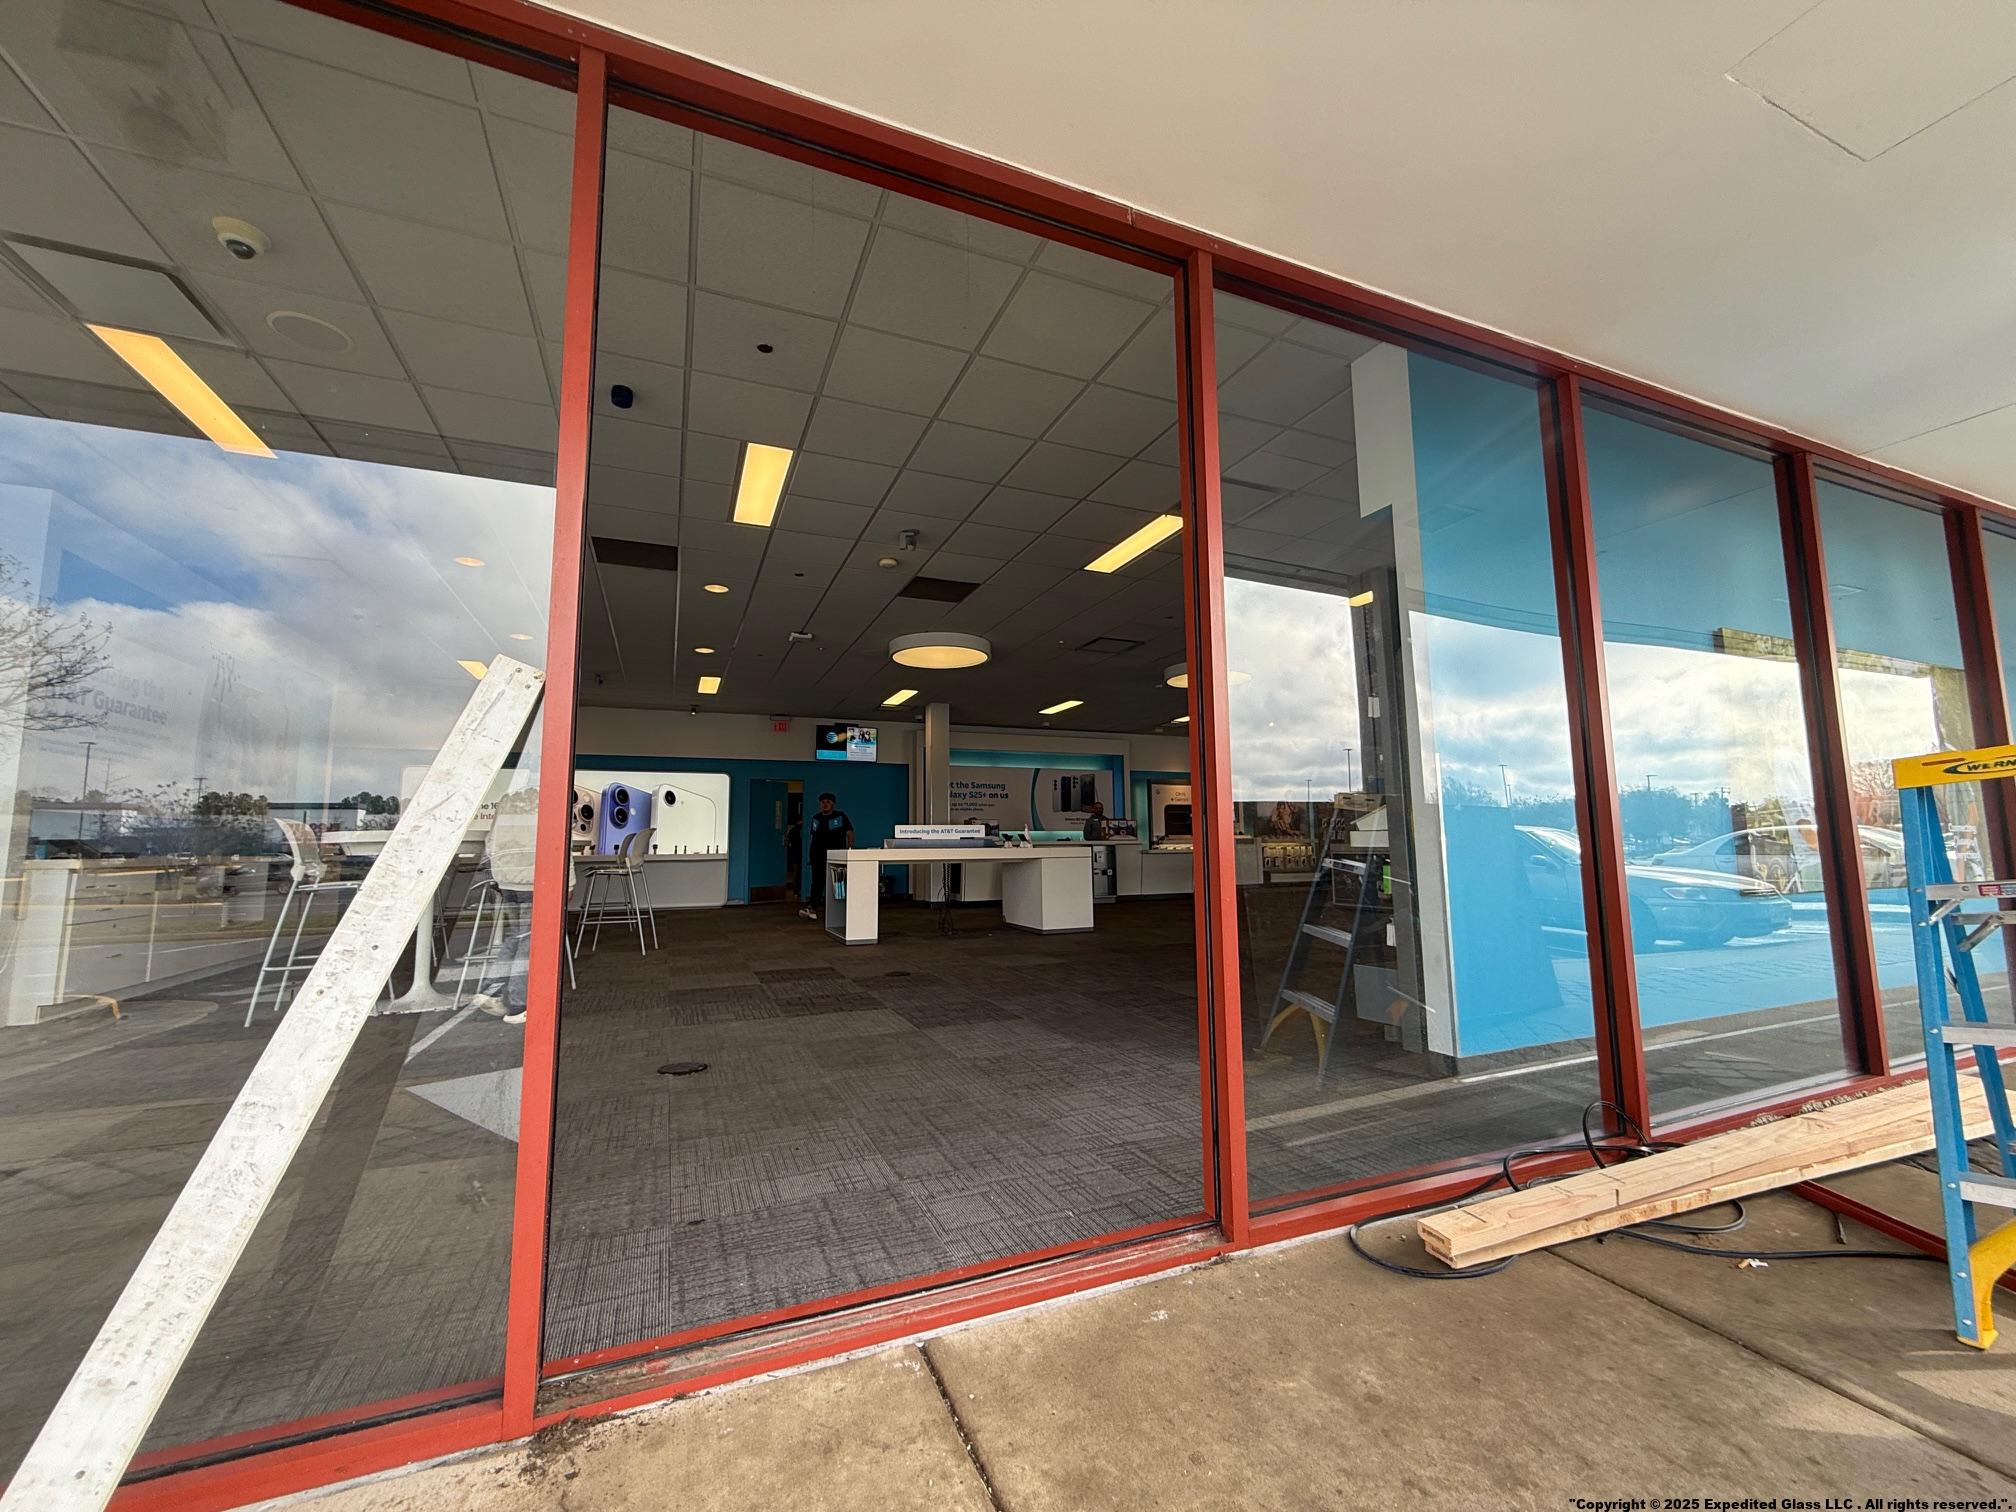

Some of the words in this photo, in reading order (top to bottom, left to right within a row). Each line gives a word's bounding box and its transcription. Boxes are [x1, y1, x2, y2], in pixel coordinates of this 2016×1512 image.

[94, 689, 167, 725] Guarantee
[1966, 759, 2016, 771] WERN
[956, 781, 969, 789] the
[971, 782, 1006, 791] Samsung
[950, 791, 967, 800] laxy
